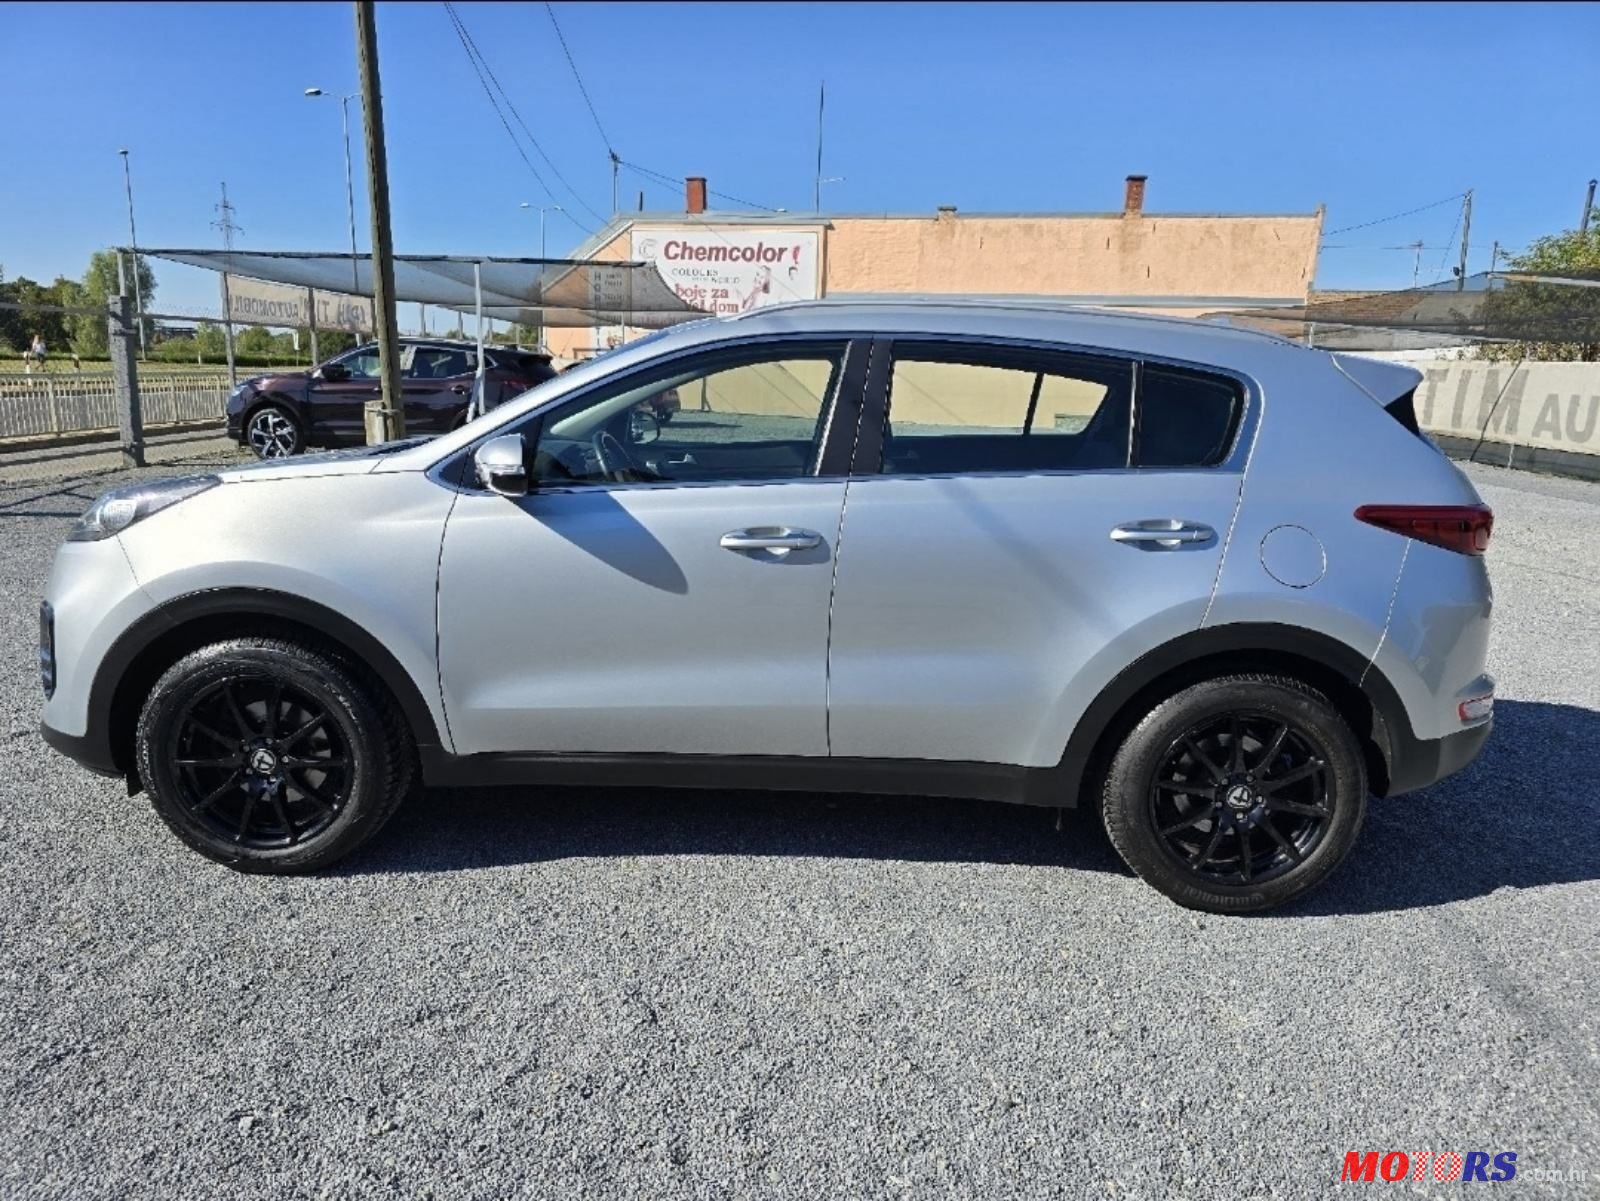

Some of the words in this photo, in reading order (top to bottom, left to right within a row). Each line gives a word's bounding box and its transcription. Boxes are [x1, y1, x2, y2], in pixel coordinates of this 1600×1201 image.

[663, 240, 788, 263] Chemcolor
[711, 287, 729, 299] za
[1422, 368, 1530, 436] TIM
